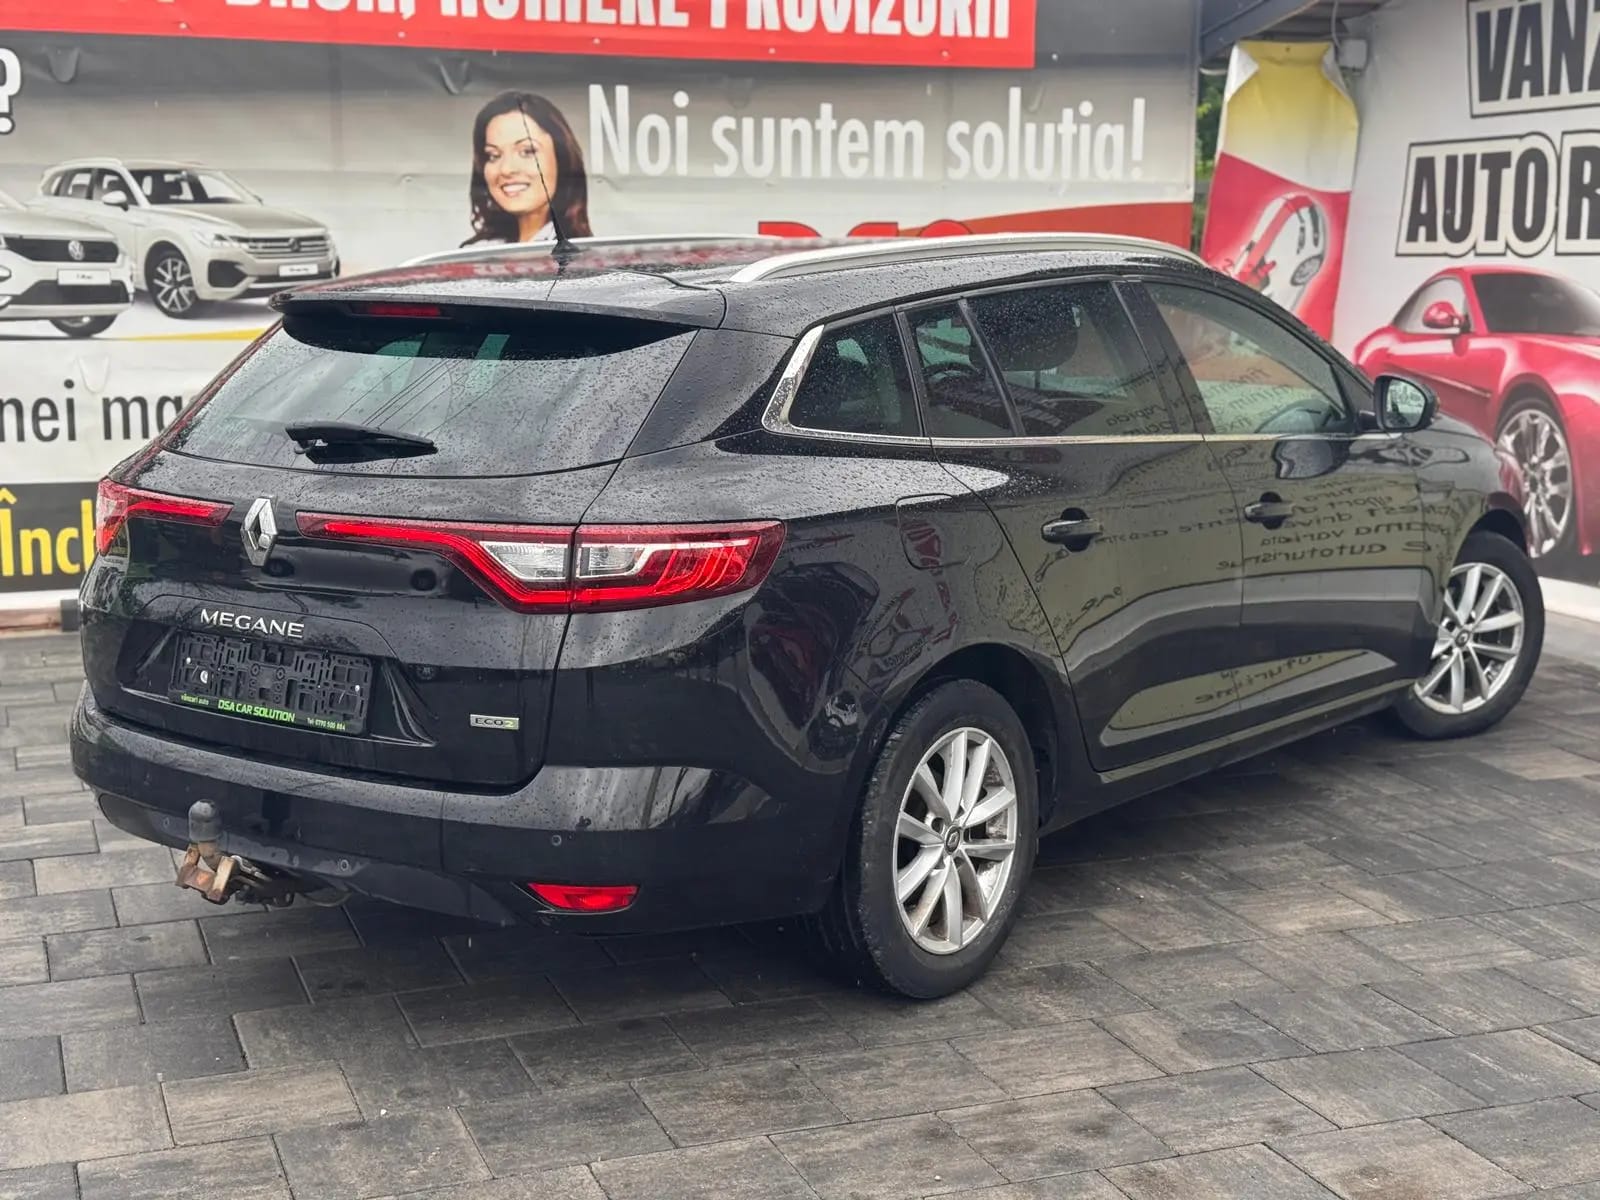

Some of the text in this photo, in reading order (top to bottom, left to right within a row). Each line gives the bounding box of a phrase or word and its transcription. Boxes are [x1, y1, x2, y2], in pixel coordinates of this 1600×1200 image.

[588, 84, 689, 177] Noi
[711, 102, 925, 181] suntem
[1405, 147, 1549, 243] AUTO
[200, 608, 305, 638] MEGANE
[217, 699, 235, 711] DSA
[236, 703, 252, 715] CAR
[253, 705, 296, 723] SOLUTION
